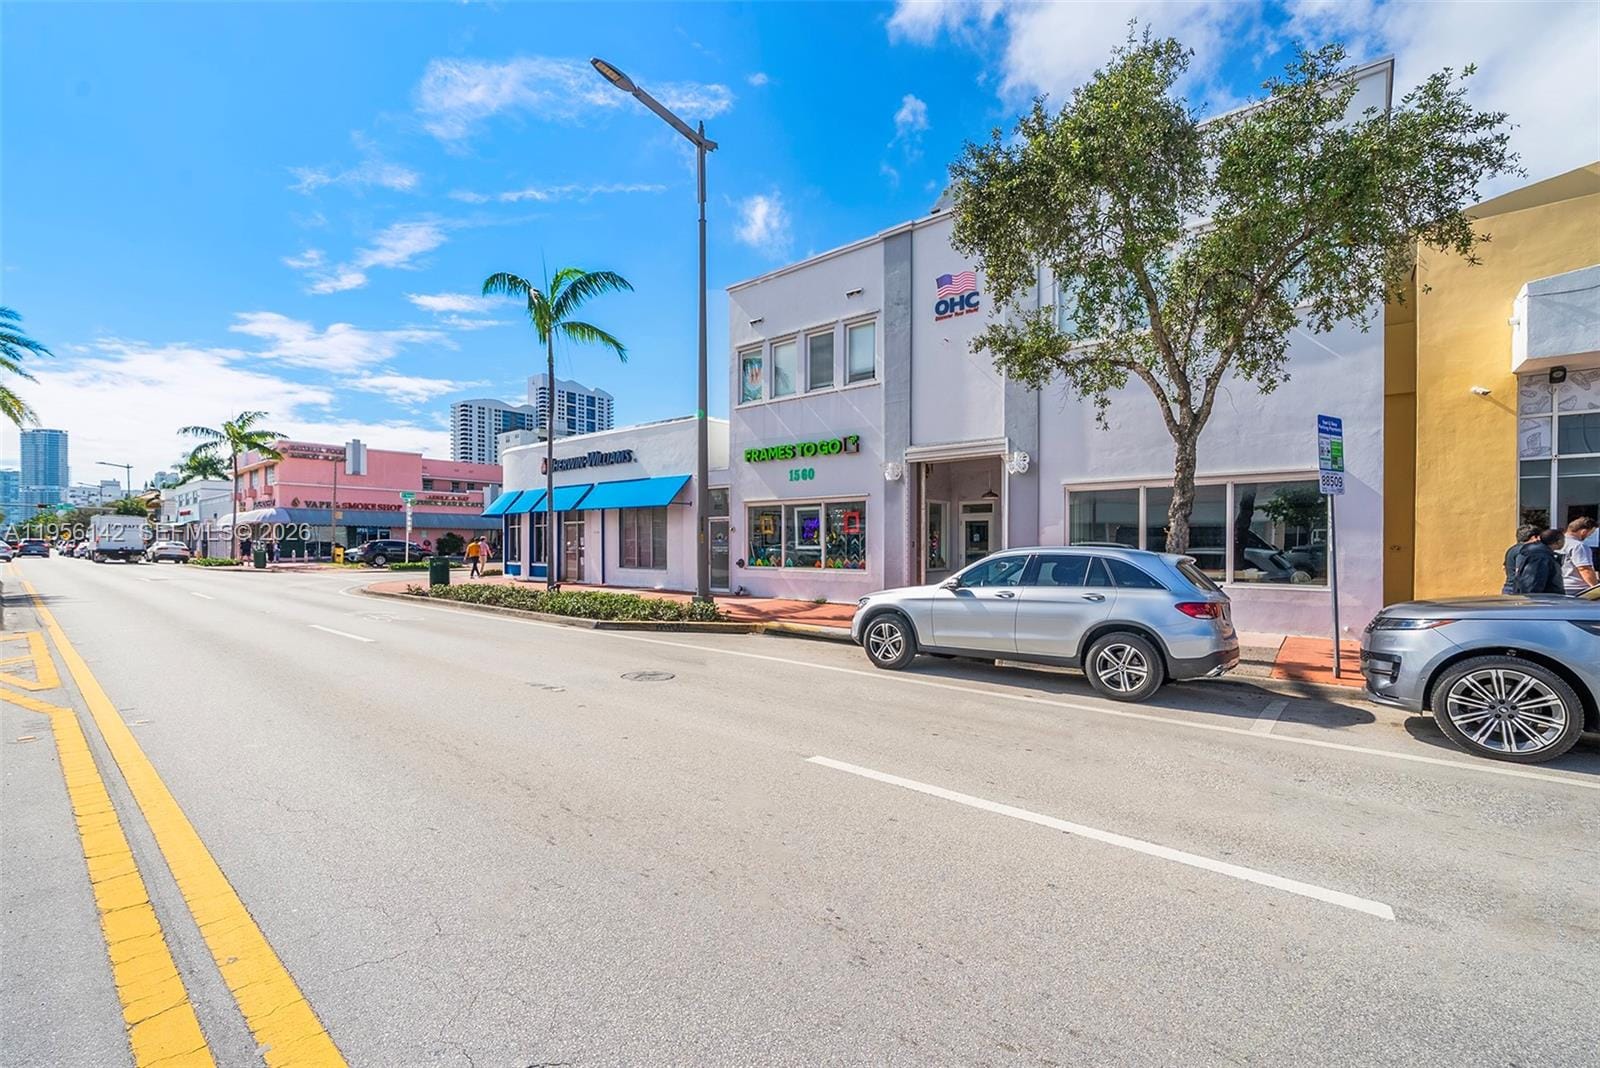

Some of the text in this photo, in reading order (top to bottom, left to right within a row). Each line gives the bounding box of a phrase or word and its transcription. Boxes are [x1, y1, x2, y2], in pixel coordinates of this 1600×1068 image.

[935, 291, 979, 315] OHC
[744, 438, 842, 463] FRAMES TO GO
[550, 449, 633, 473] HERWIN-WILLIAMS
[788, 467, 815, 481] 1560
[1321, 475, 1343, 487] 88509
[304, 501, 332, 509] VAPE
[341, 502, 377, 511] SMOKE
[377, 503, 403, 512] SHOP
